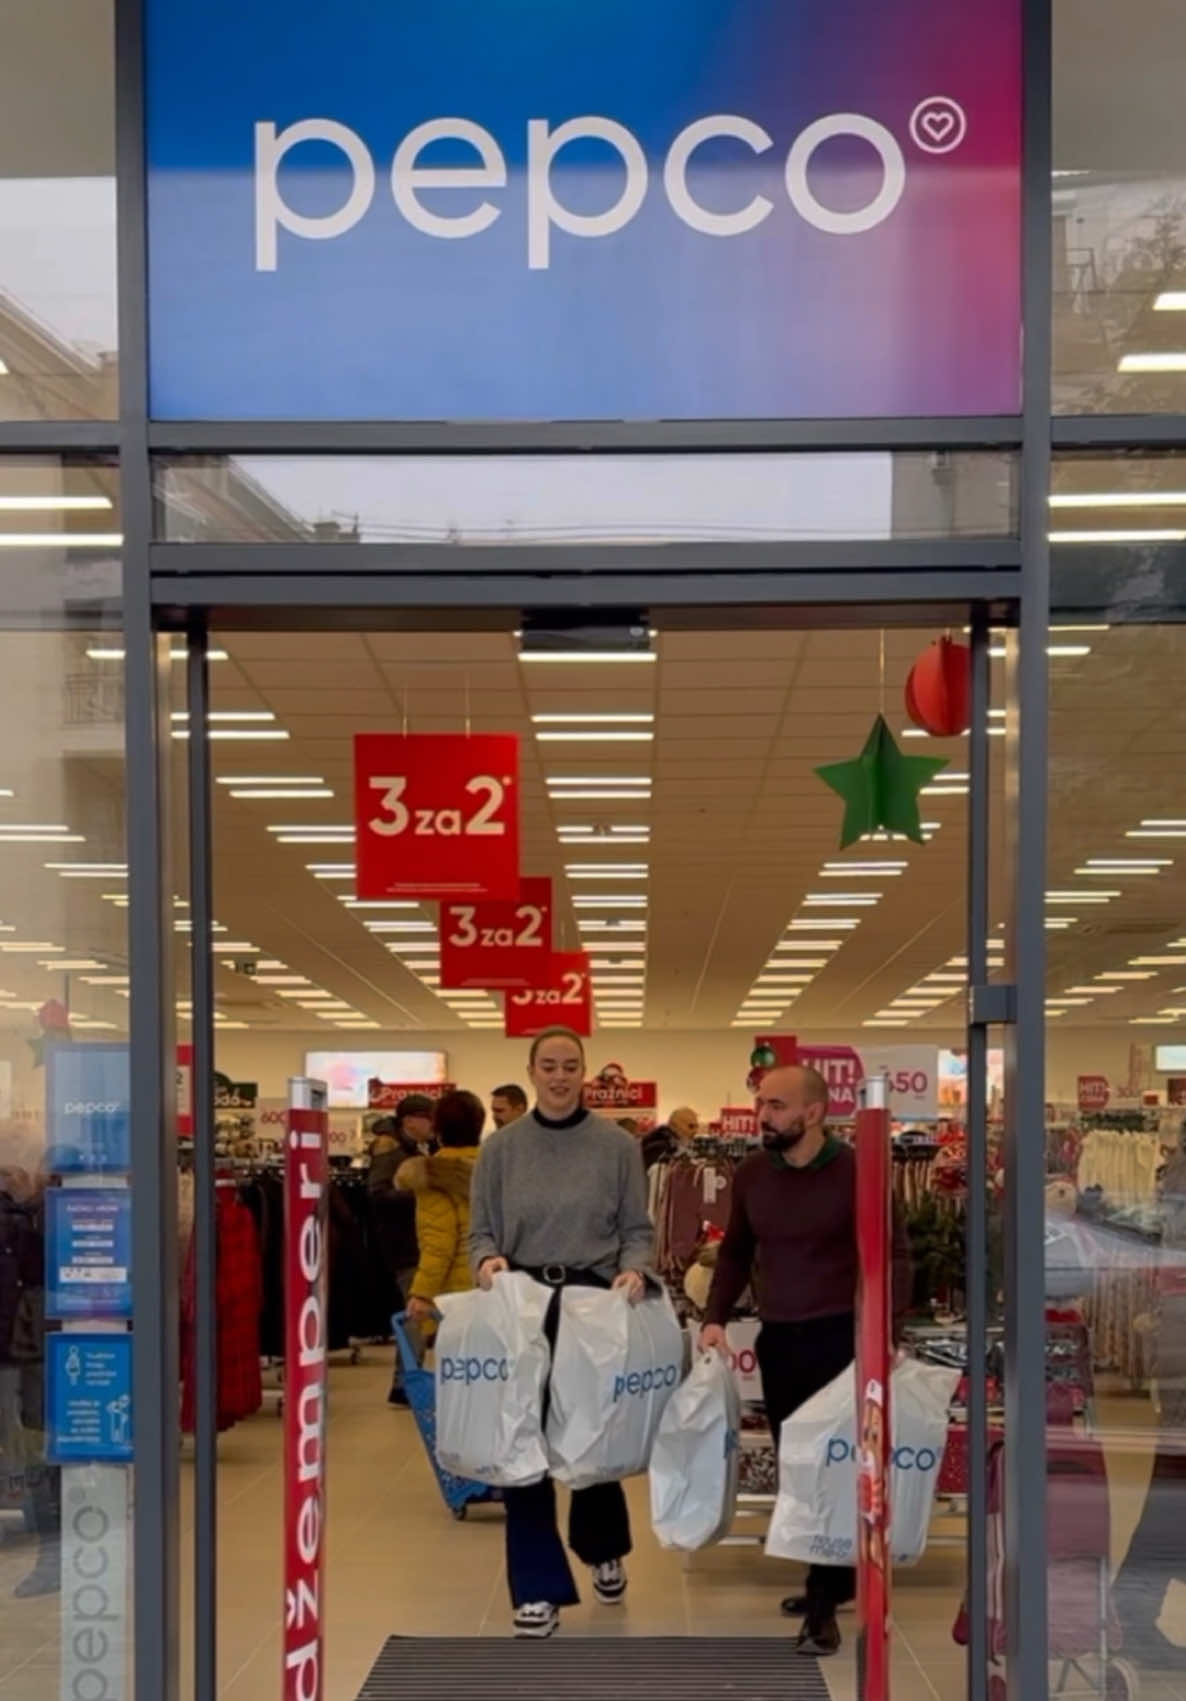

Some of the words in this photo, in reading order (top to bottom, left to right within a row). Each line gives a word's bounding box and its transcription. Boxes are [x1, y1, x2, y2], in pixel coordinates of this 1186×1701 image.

[254, 112, 906, 271] pepco
[368, 776, 409, 836] 3
[414, 809, 462, 835] za
[449, 906, 477, 947] 3
[481, 928, 513, 946] za
[286, 1129, 322, 1701] džemperi
[825, 1437, 937, 1472] pco
